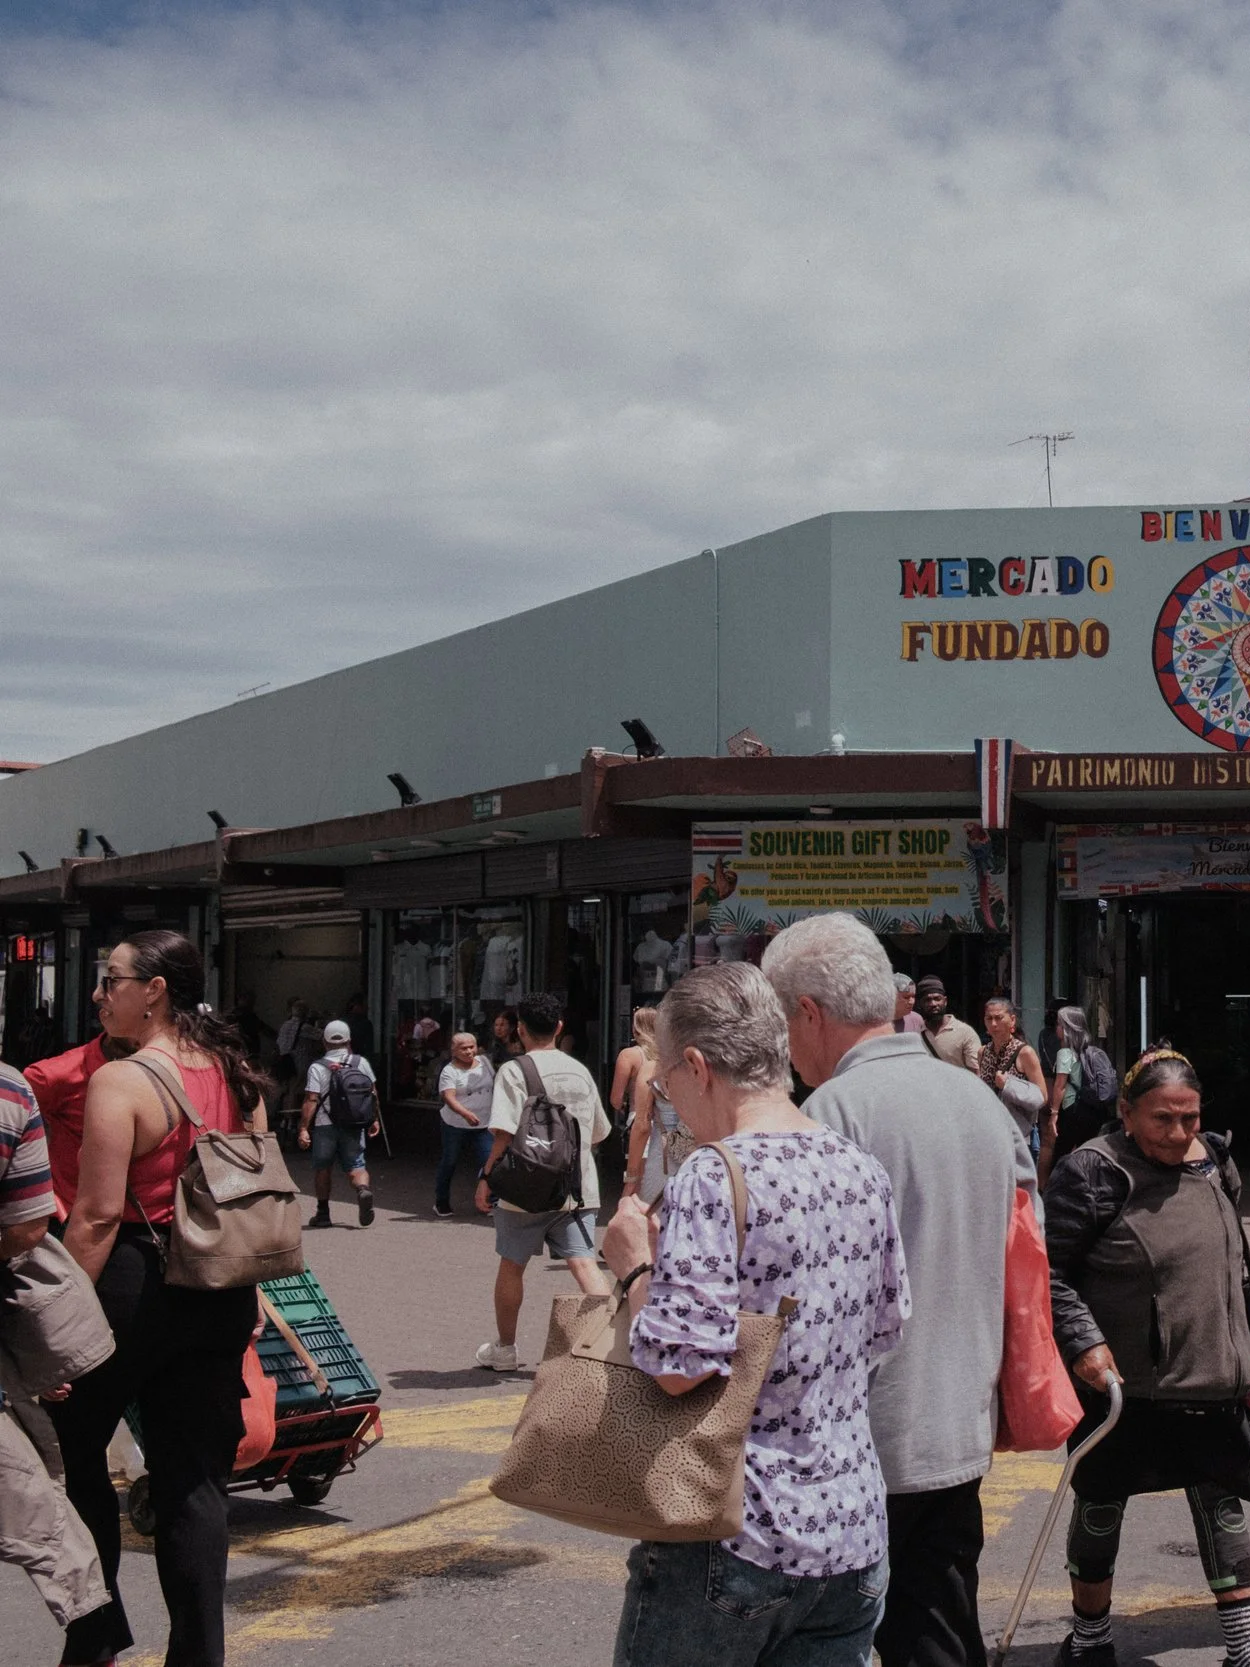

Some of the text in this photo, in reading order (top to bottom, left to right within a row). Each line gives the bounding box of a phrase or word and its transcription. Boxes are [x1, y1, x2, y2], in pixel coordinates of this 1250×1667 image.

[899, 556, 1115, 599] MERCADO
[901, 617, 1110, 662] FUNDADO
[750, 829, 950, 856] SOUVENIR GIFT SHOP
